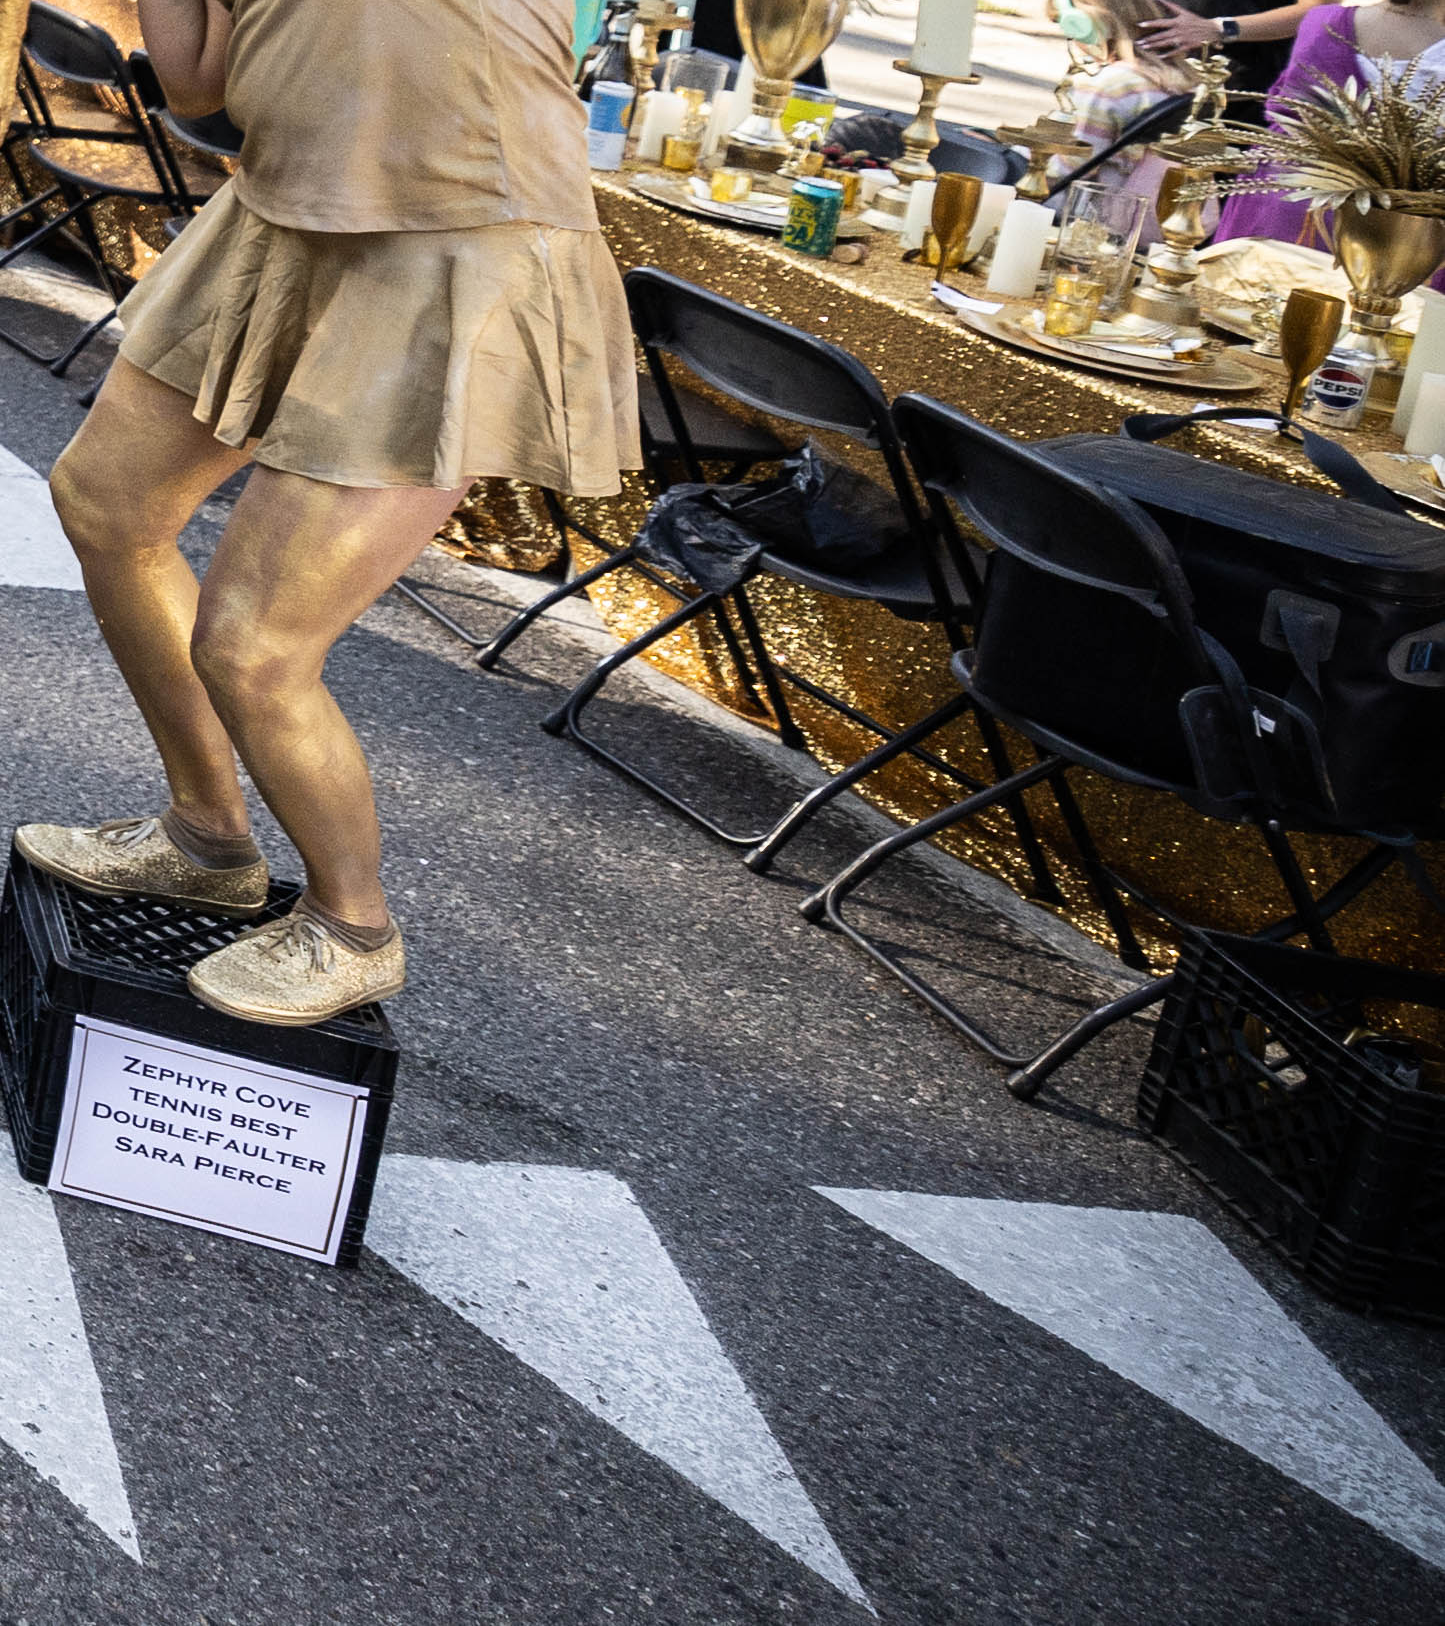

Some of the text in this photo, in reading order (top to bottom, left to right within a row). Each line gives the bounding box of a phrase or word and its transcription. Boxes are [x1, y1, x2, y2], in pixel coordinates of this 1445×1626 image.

[1314, 378, 1364, 397] PEPSI
[122, 1055, 311, 1119] ZEPHYR COVE
[128, 1086, 298, 1141] TENNIS BEST
[92, 1101, 326, 1175] DOUBLE-FAULTER
[114, 1136, 292, 1194] SARA PIERCE
